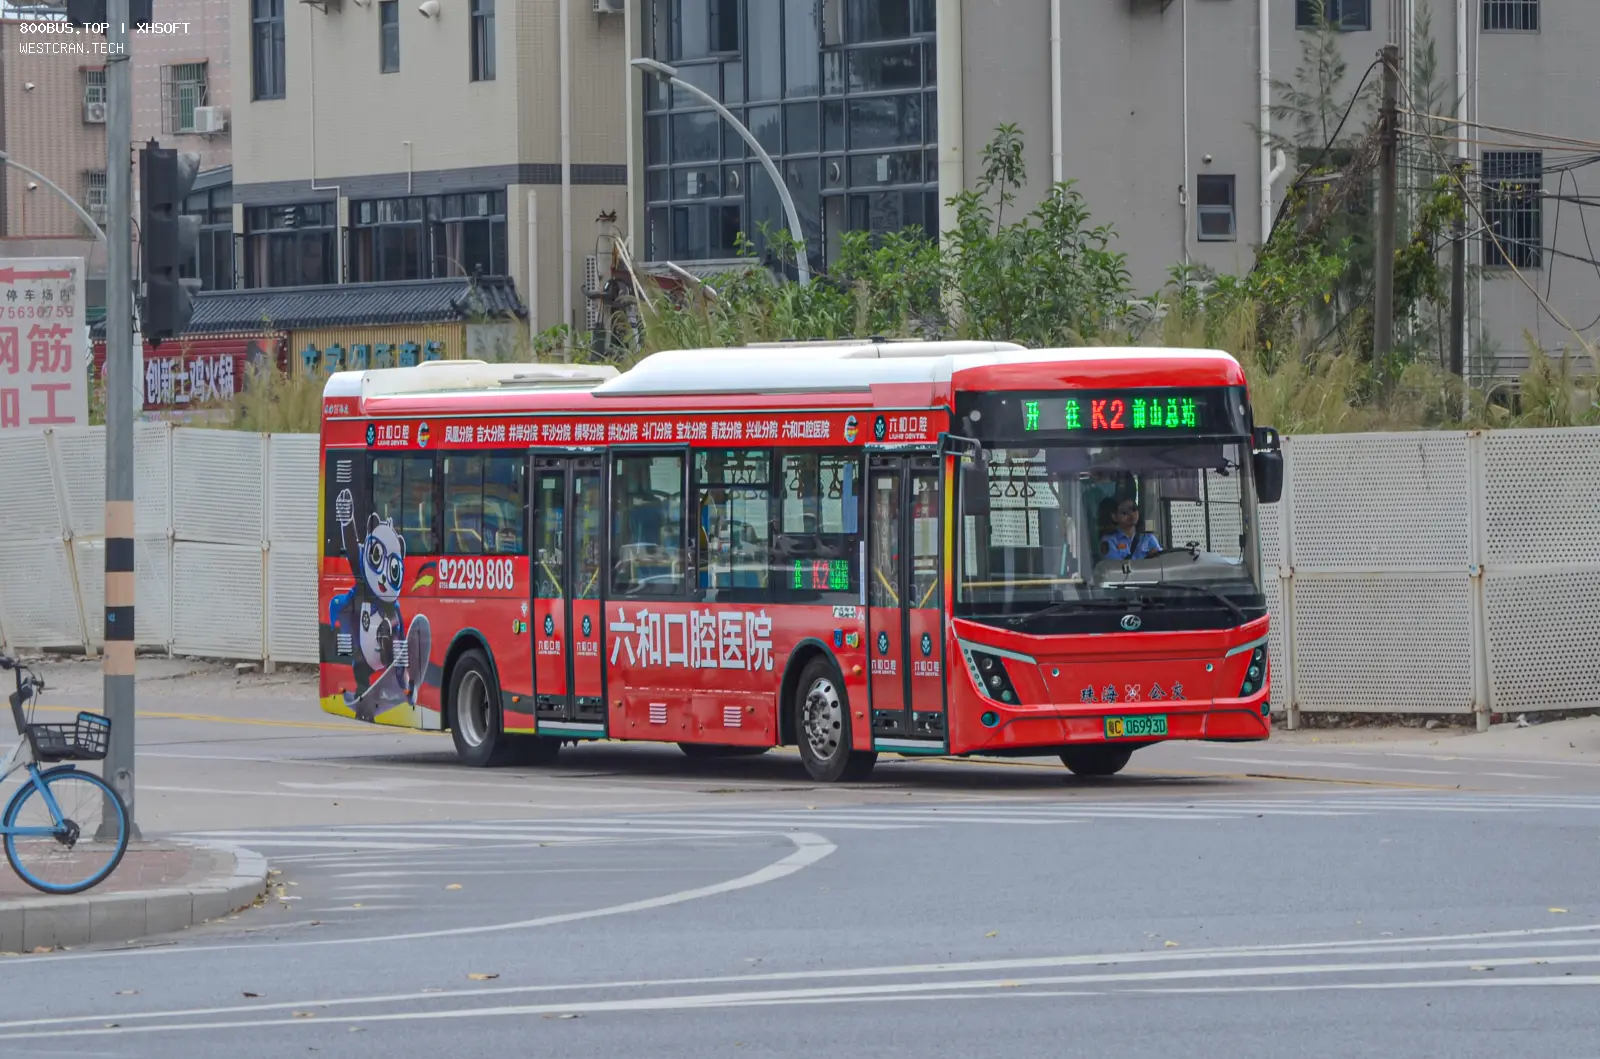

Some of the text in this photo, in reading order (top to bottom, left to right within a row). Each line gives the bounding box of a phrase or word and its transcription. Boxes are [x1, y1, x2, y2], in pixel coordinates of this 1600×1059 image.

[889, 417, 928, 432] 六和口腔
[1091, 399, 1125, 429] K2
[1132, 398, 1196, 428] 前山总站
[477, 425, 505, 443] 吉大分院
[509, 424, 538, 442] 井岸分院
[542, 423, 571, 442] 平沙分院
[575, 423, 605, 441] 横琴分院
[608, 422, 638, 441] 拱北分院
[642, 422, 672, 440] 斗门分院
[746, 420, 778, 439] 兴业分院
[782, 420, 830, 439] 六和口腔医院
[449, 559, 484, 589] 2299
[486, 559, 514, 590] 808
[609, 607, 774, 671] 六和口腔医院
